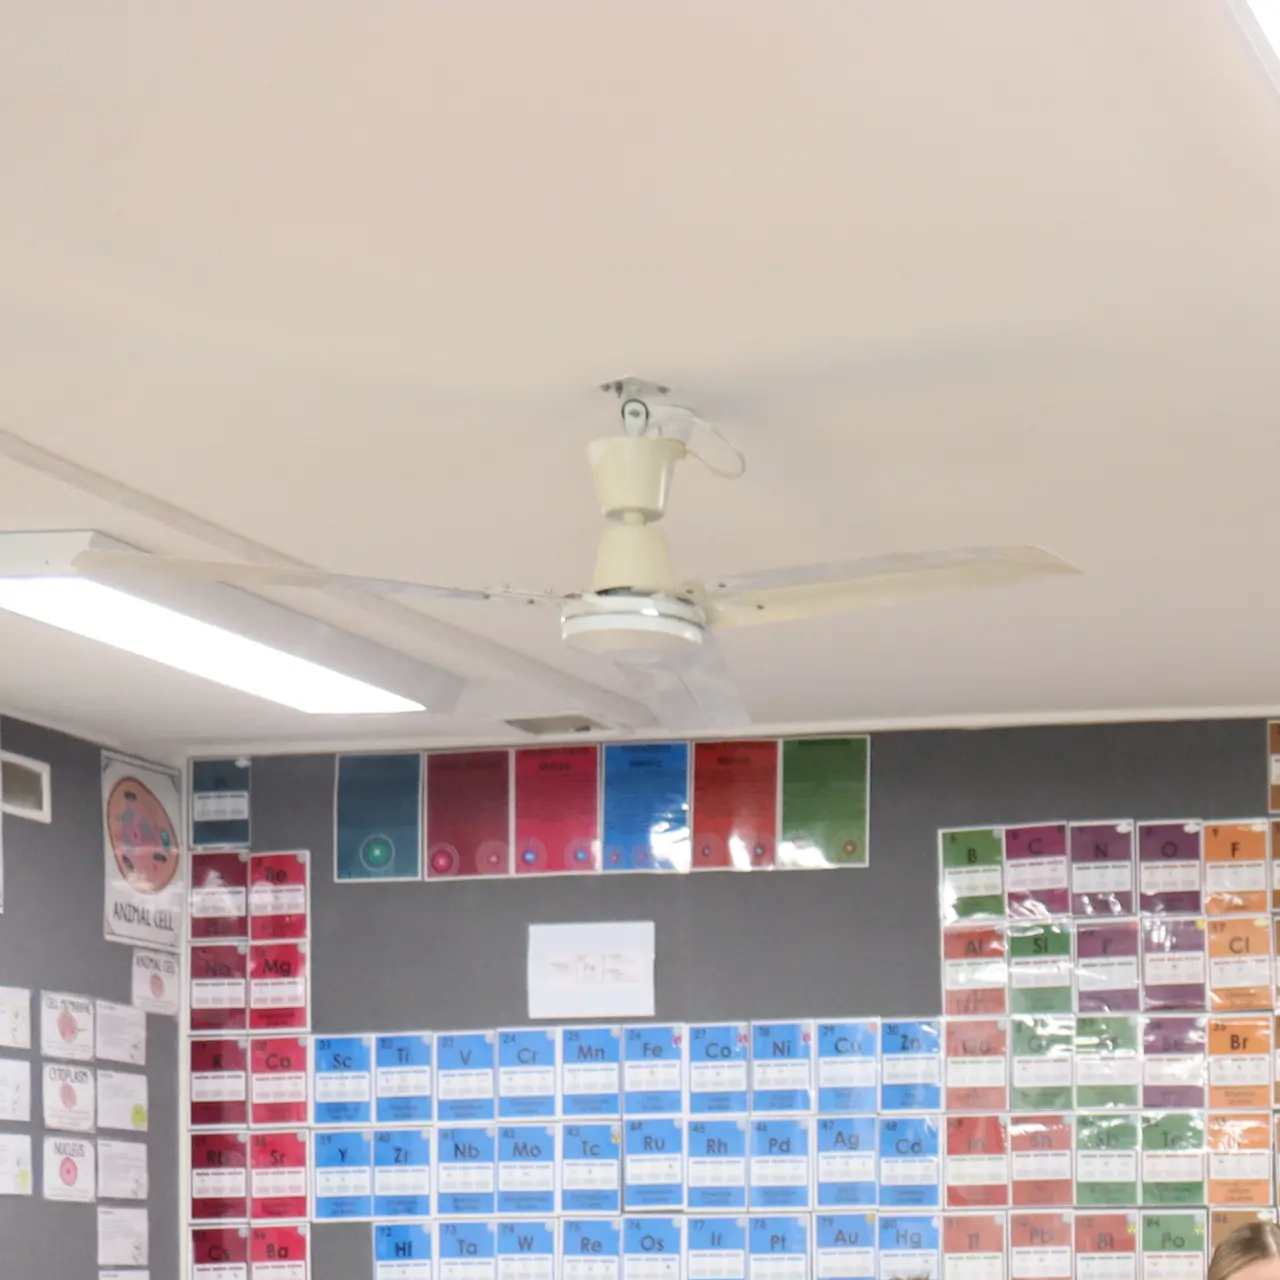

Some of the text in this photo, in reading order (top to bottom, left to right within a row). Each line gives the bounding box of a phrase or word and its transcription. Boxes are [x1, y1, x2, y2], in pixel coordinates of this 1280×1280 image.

[112, 900, 175, 932] ANIMAL CELL
[1228, 936, 1251, 954] Cl
[204, 960, 232, 977] Na
[262, 958, 292, 977] Mg
[642, 1042, 664, 1058] Fe
[704, 1042, 733, 1060] Co
[771, 1039, 792, 1057] Ni
[833, 1036, 862, 1055] Cu
[899, 1033, 922, 1052] Zn
[1229, 1033, 1250, 1051] Br
[395, 1047, 411, 1065] Ti
[459, 1049, 473, 1066] V
[516, 1047, 539, 1064] Cr
[576, 1043, 606, 1060] Mn
[264, 1054, 293, 1070] Ca
[332, 1052, 354, 1070] Sc
[512, 1141, 543, 1158] Mo
[580, 1139, 601, 1157] Tc
[642, 1135, 666, 1152] Ru
[705, 1137, 729, 1155] Rh
[768, 1136, 791, 1154] Pd
[832, 1130, 860, 1151] Ag
[894, 1137, 924, 1155] Cd
[269, 1150, 287, 1166] Sr
[337, 1147, 348, 1163] Y
[392, 1146, 411, 1165] Zr
[453, 1142, 481, 1159] Nb
[516, 1235, 535, 1251] W
[580, 1236, 603, 1254] Re
[639, 1234, 665, 1252] Os
[769, 1234, 788, 1251] Pt
[832, 1228, 860, 1246] Au
[894, 1228, 923, 1249] Hg
[1160, 1231, 1186, 1250] Po
[206, 1245, 230, 1262] Cs
[265, 1243, 289, 1261] Ba
[394, 1240, 413, 1258] Hf
[456, 1239, 478, 1256] Ta
